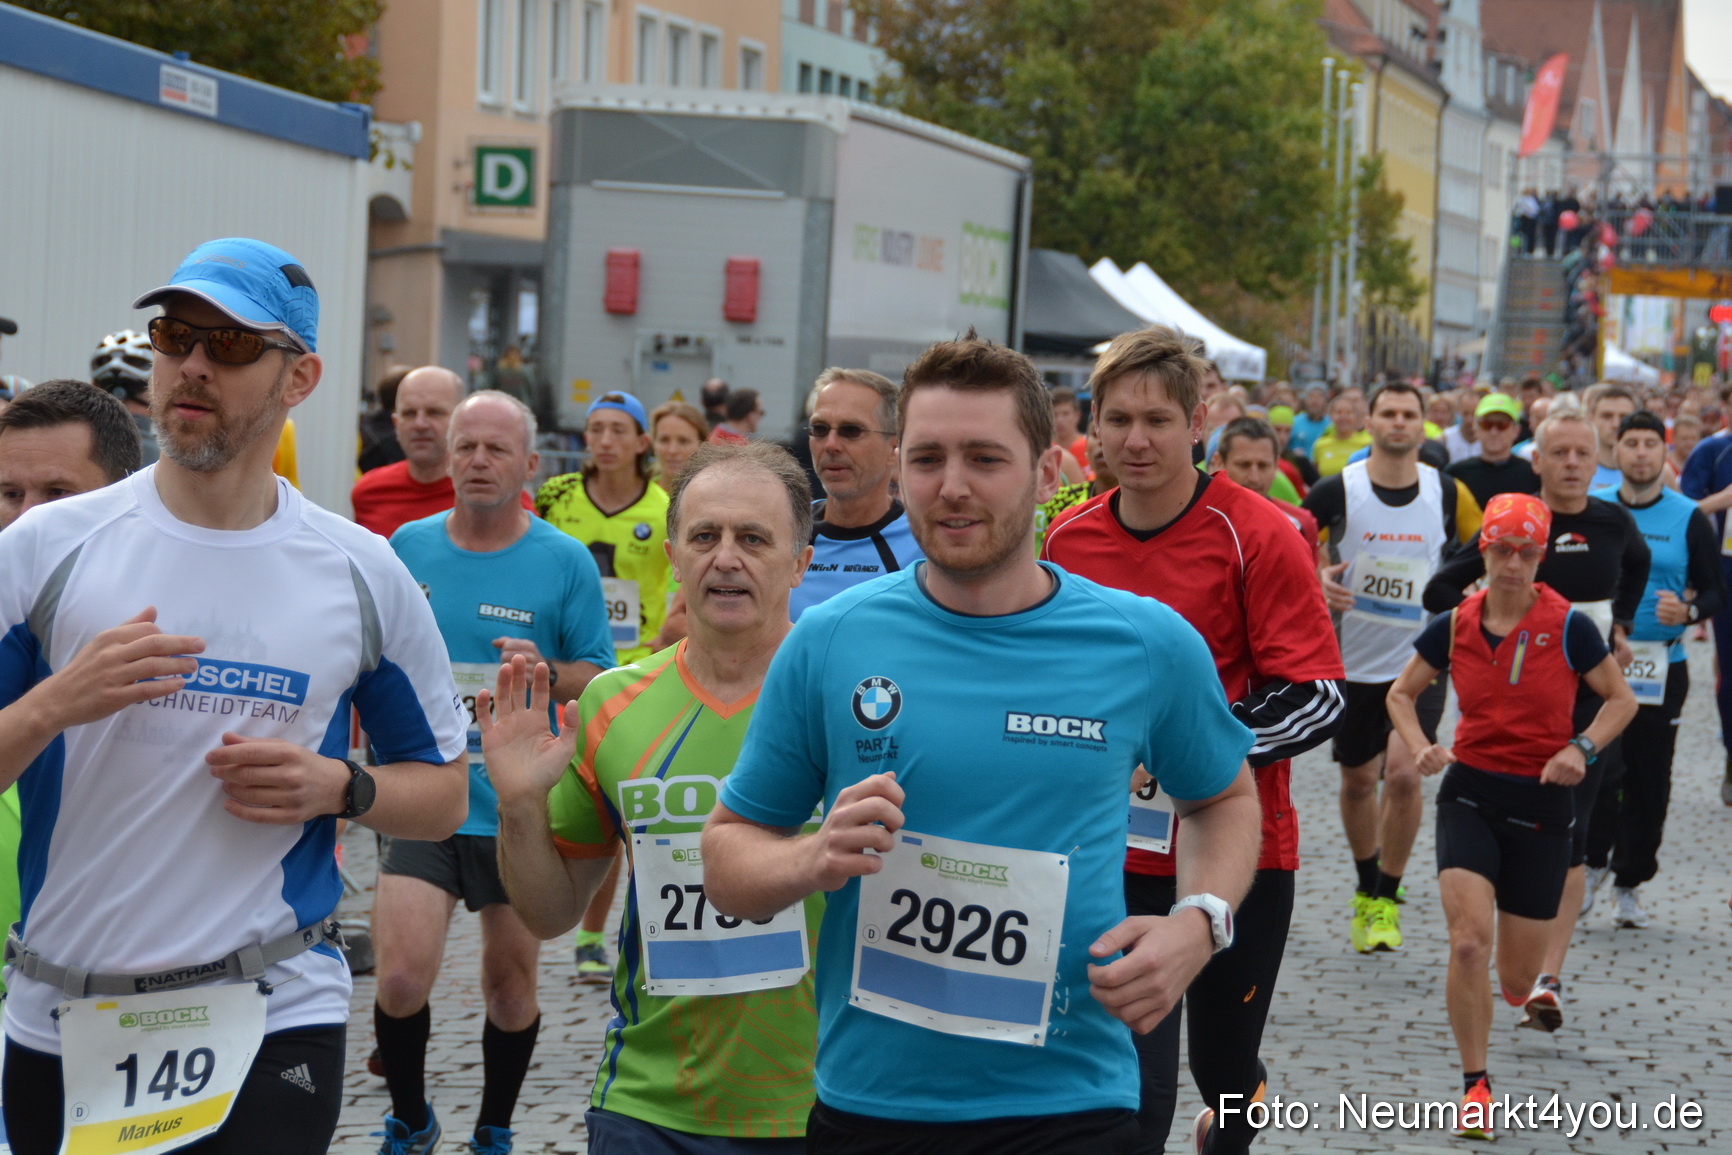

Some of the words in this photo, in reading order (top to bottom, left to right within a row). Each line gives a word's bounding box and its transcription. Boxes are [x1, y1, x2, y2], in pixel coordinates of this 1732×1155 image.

[482, 152, 528, 201] D
[1363, 574, 1414, 600] 2051
[479, 603, 534, 624] BOCK
[856, 678, 898, 695] BMW
[1005, 711, 1108, 743] BOCK
[1038, 738, 1047, 746] by
[1050, 740, 1075, 748] smart
[1076, 742, 1108, 753] concepts
[939, 856, 1008, 882] BOCK
[660, 884, 775, 929] 27
[650, 925, 656, 934] D
[868, 929, 876, 939] D
[886, 889, 1029, 966] 2926
[148, 959, 226, 986] NATHAN
[140, 1006, 209, 1026] BOCK
[115, 1047, 216, 1108] 149
[281, 1072, 315, 1094] adidas
[76, 1107, 84, 1118] D
[117, 1116, 184, 1143] Markus
